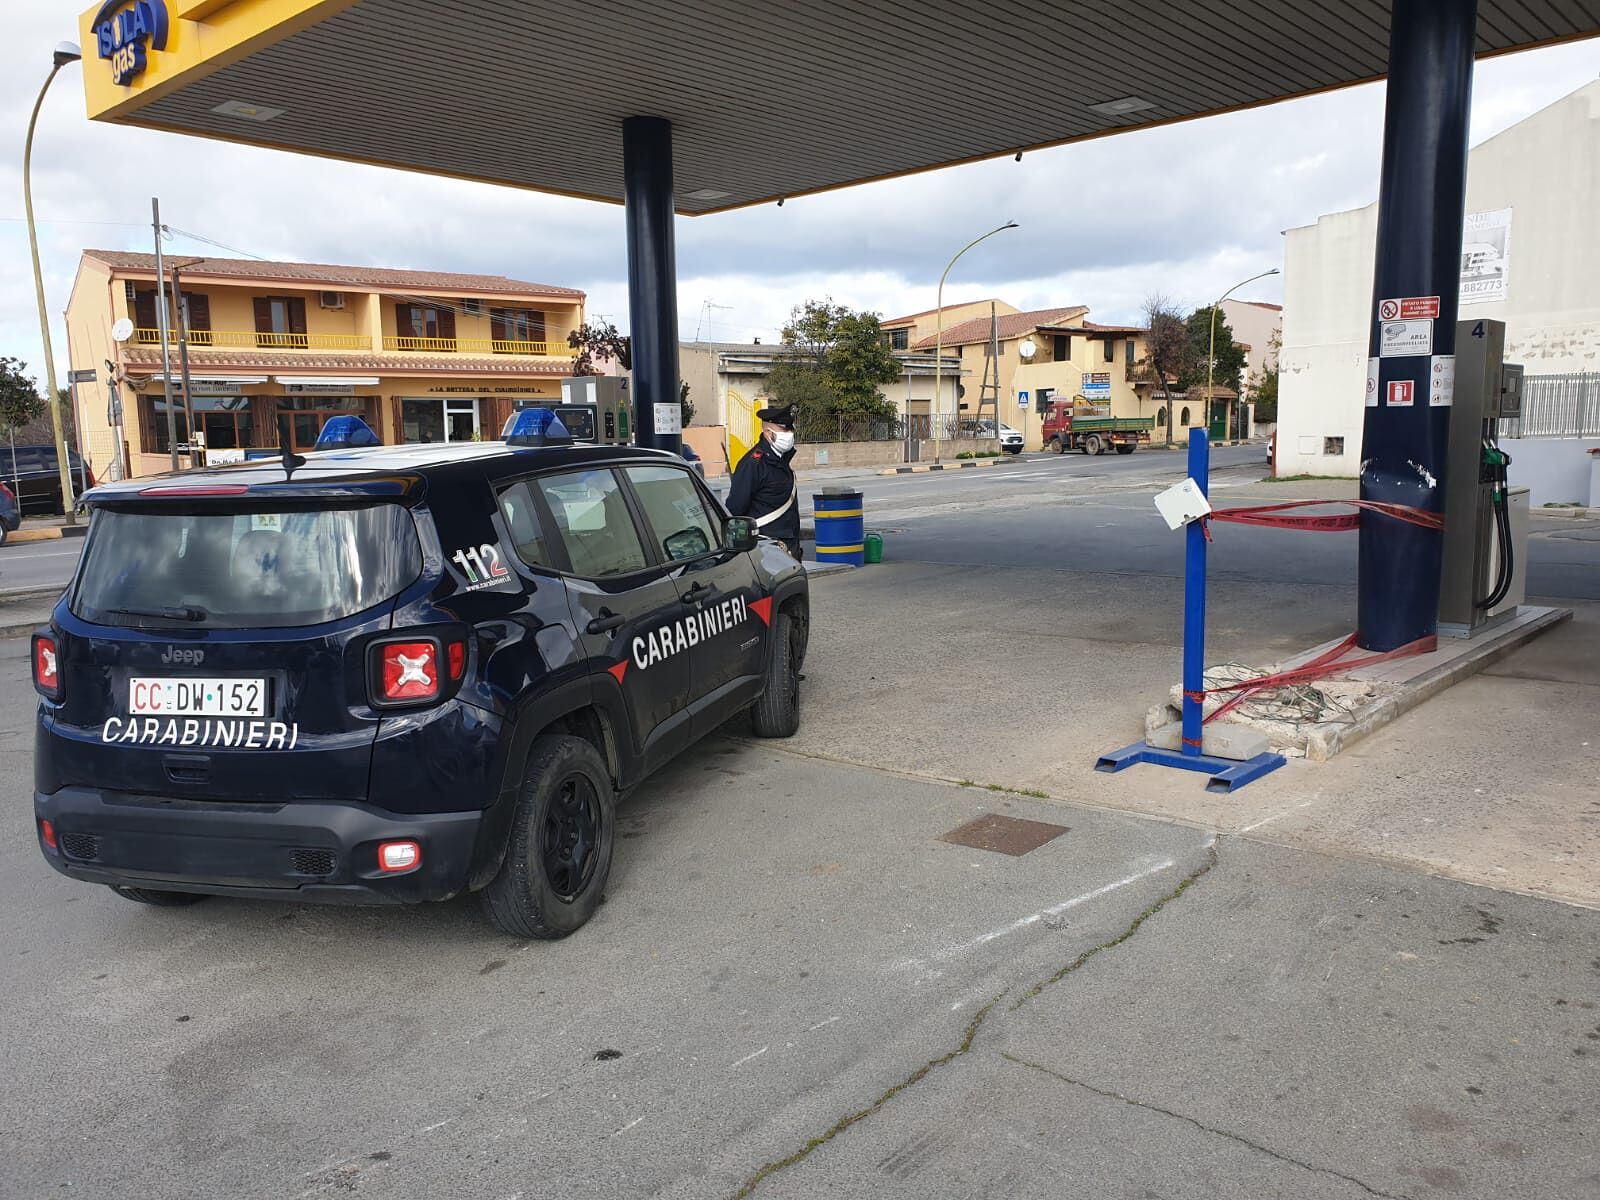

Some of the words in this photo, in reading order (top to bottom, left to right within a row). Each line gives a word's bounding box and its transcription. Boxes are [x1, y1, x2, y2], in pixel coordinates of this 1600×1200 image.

[97, 2, 146, 58] ISOLA
[113, 43, 135, 84] gas
[1471, 321, 1485, 338] 4
[620, 378, 628, 389] 2
[452, 543, 508, 583] 112
[632, 594, 748, 671] CARABINIERI
[161, 645, 205, 666] Jeep
[134, 683, 162, 711] CC
[177, 683, 204, 711] DW
[217, 683, 259, 712] 152
[102, 717, 299, 750] CARABINIERI
